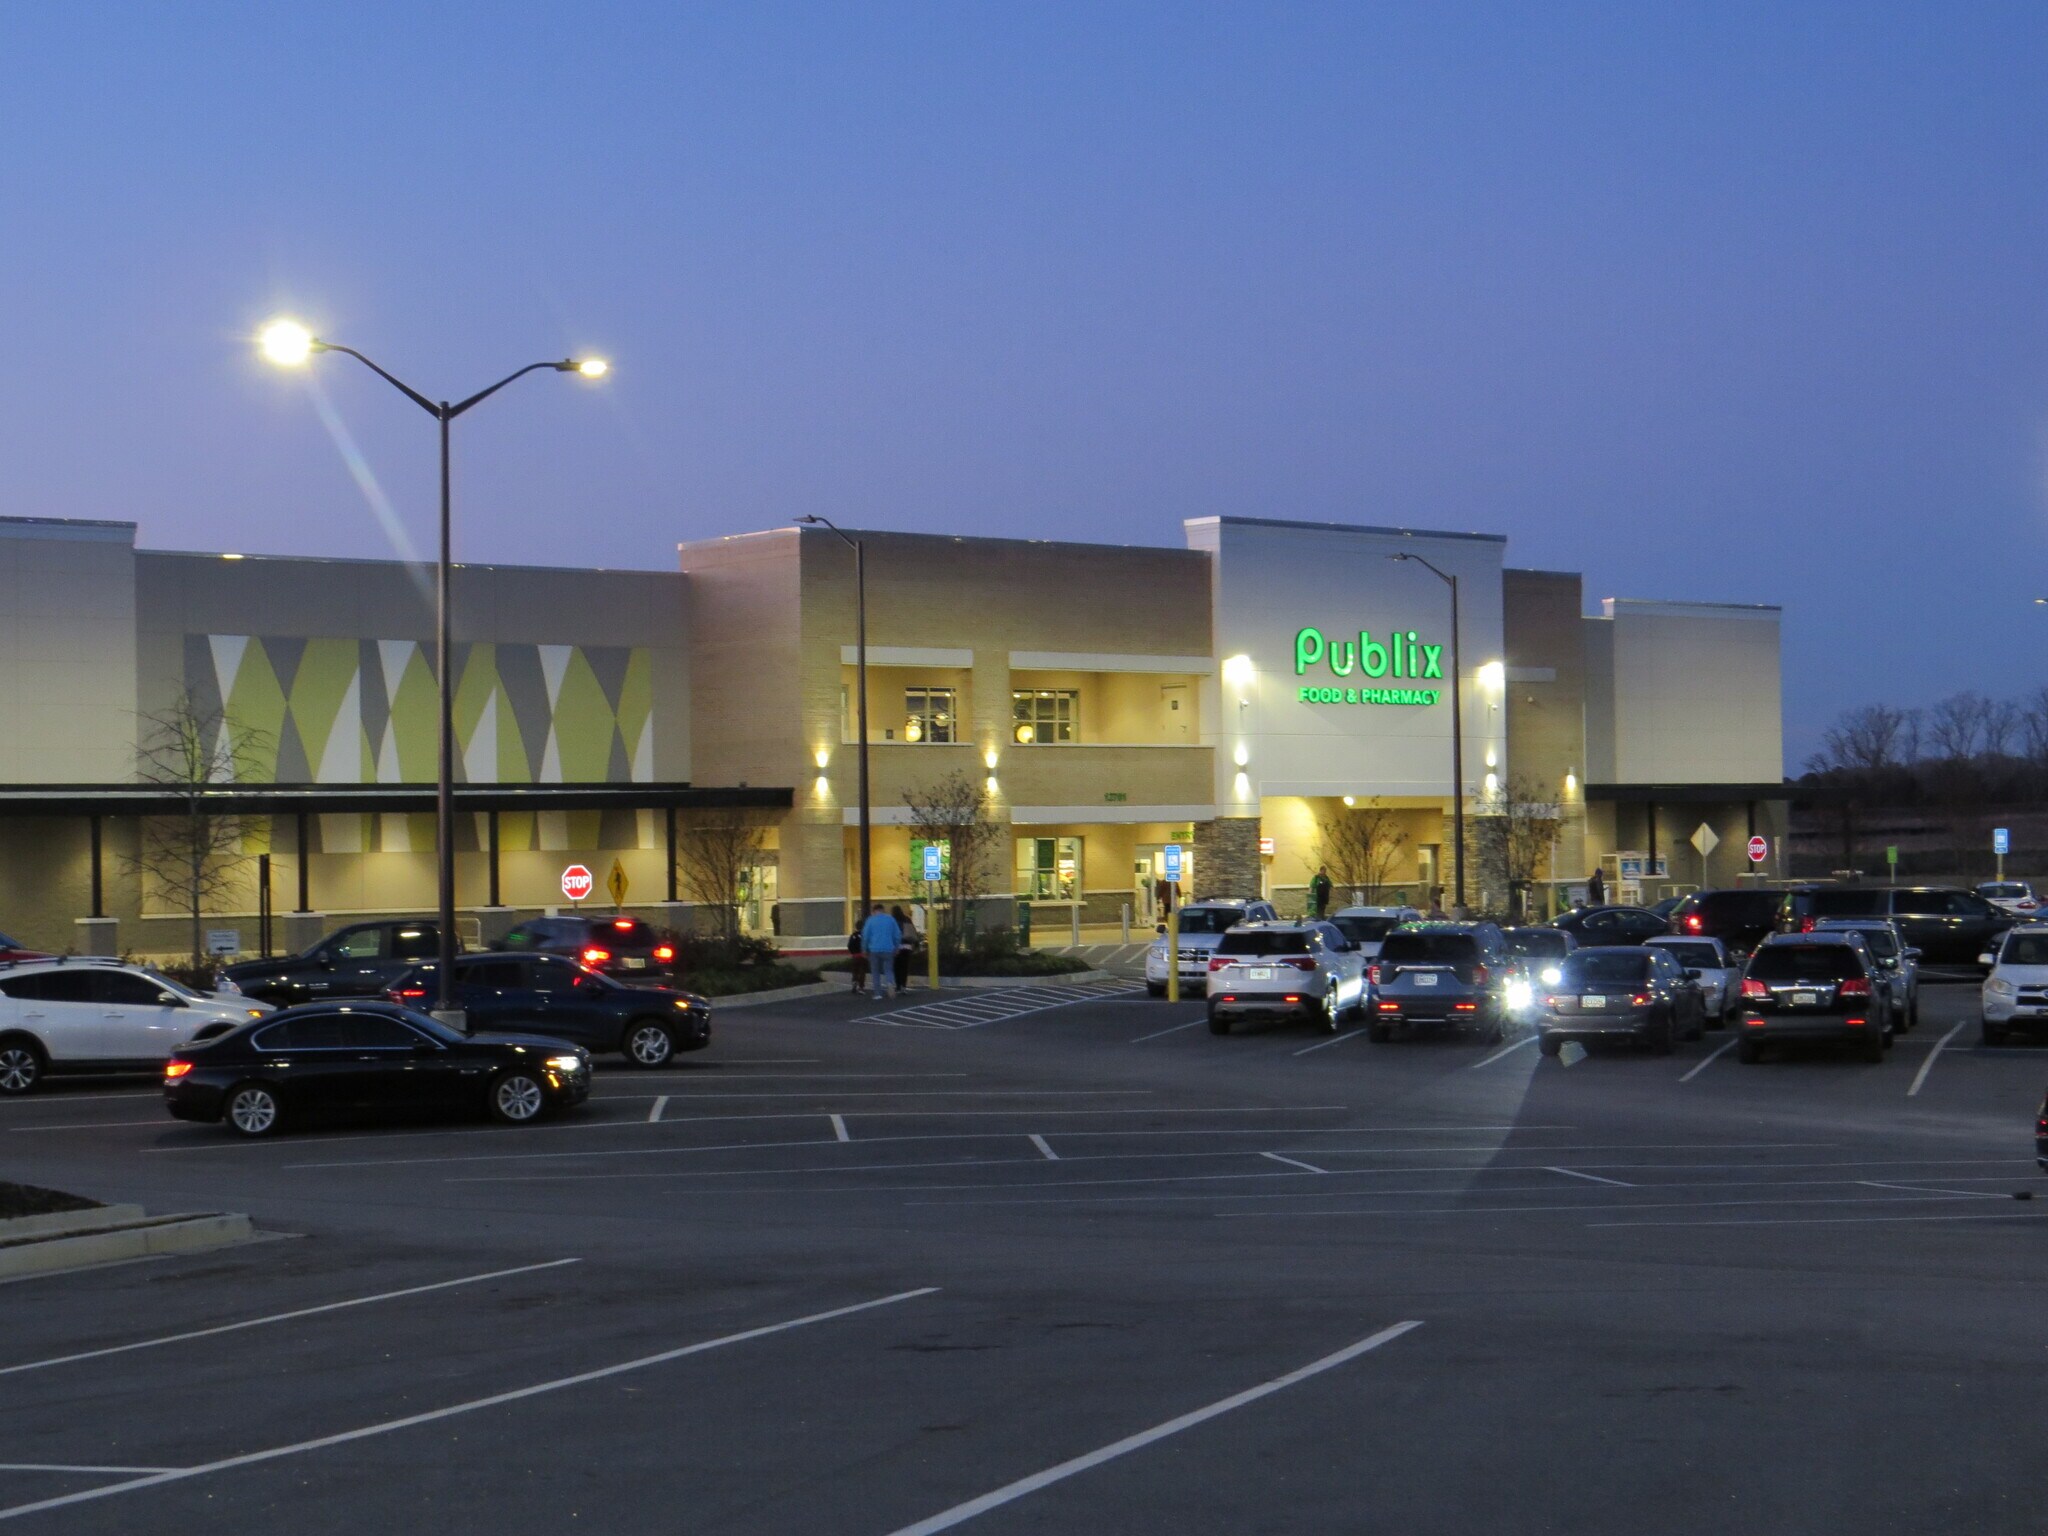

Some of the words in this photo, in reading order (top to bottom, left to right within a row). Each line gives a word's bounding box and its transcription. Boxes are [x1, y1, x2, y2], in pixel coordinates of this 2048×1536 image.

[1295, 627, 1442, 679] Publix
[1298, 687, 1343, 704] FOOD
[1346, 688, 1358, 704] &
[1360, 689, 1440, 705] PHARMACY
[1750, 845, 1765, 854] STOP
[565, 876, 590, 889] STOP
